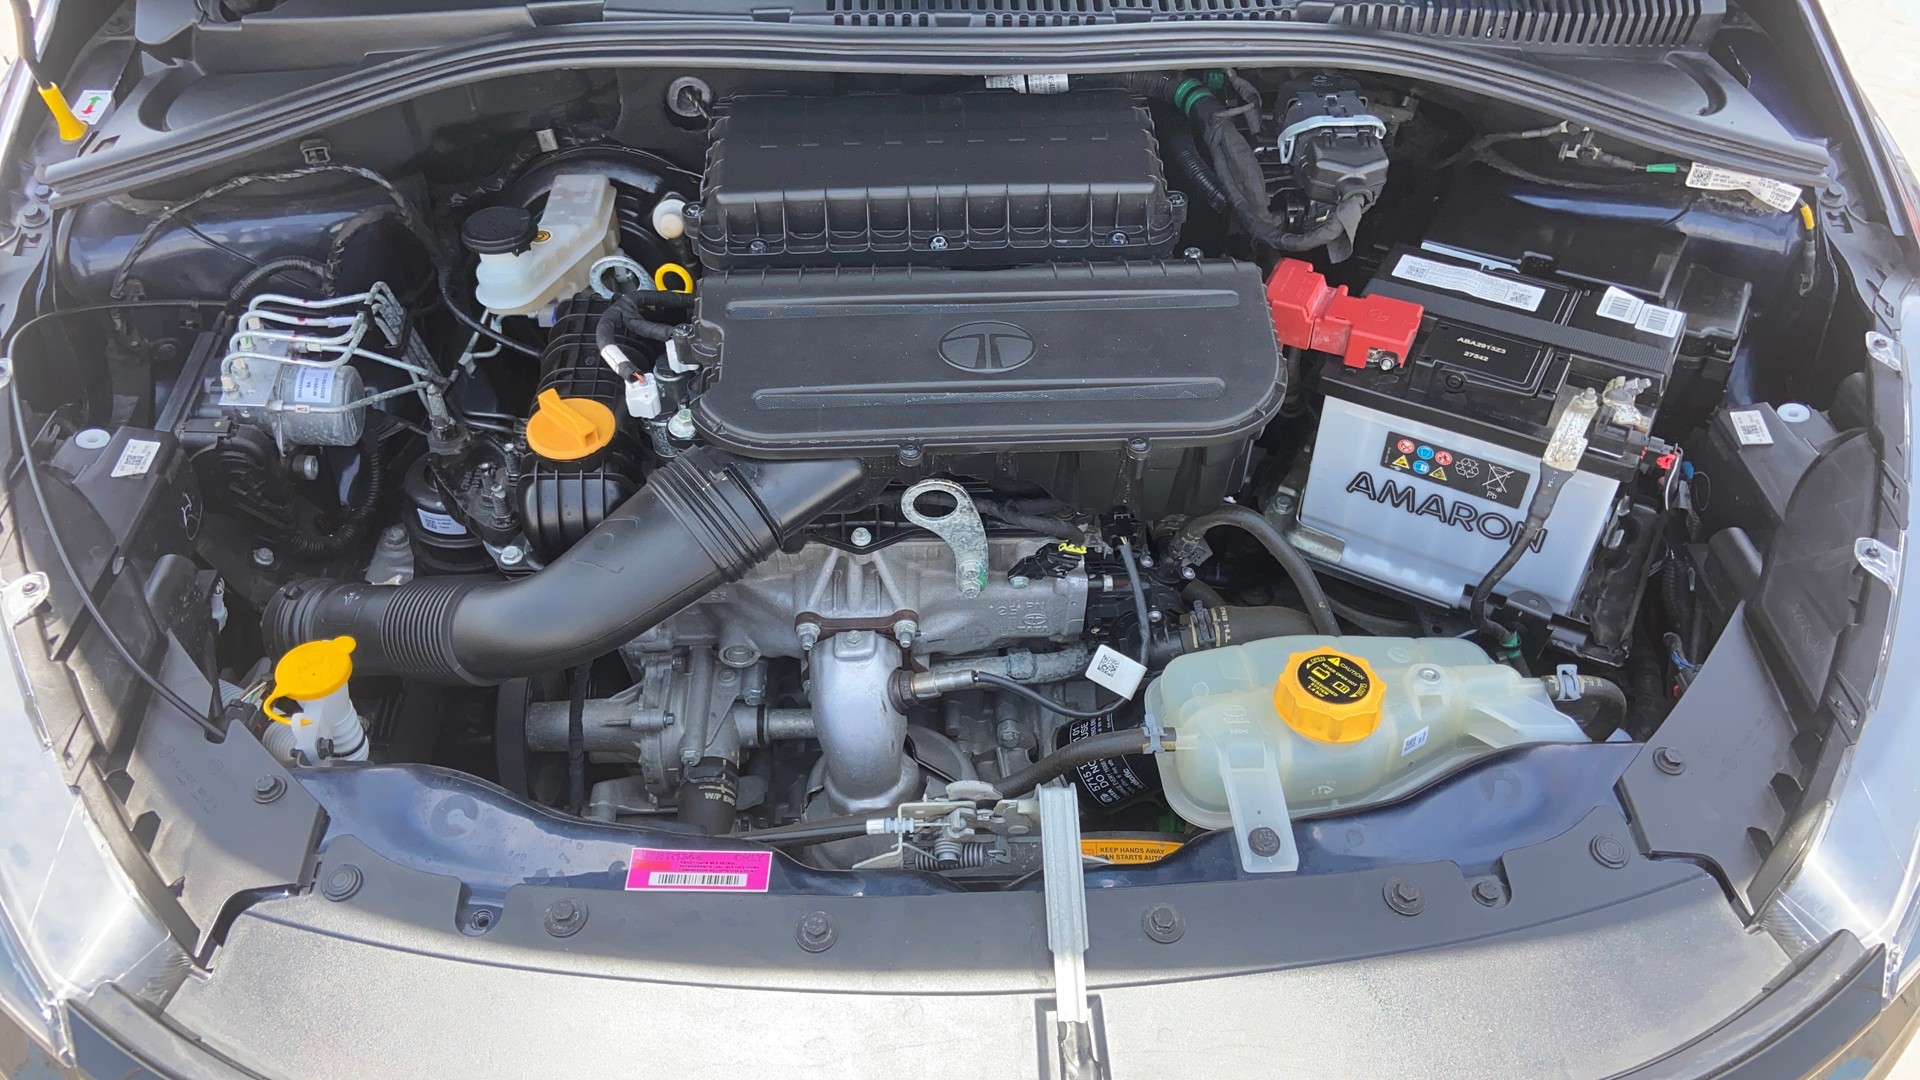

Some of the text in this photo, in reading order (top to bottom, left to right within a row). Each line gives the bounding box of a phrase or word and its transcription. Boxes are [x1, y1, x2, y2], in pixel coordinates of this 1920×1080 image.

[1486, 490, 1498, 500] Pb
[1346, 471, 1548, 553] AMARON
[1321, 662, 1358, 687] NEVER OPEN HOT
[1340, 663, 1365, 680] CAUTION
[1310, 682, 1329, 696] SYSTEM
[1080, 721, 1089, 740] USE
[1083, 771, 1101, 792] 5715
[1095, 773, 1109, 789] DO
[1107, 788, 1121, 800] TATA
